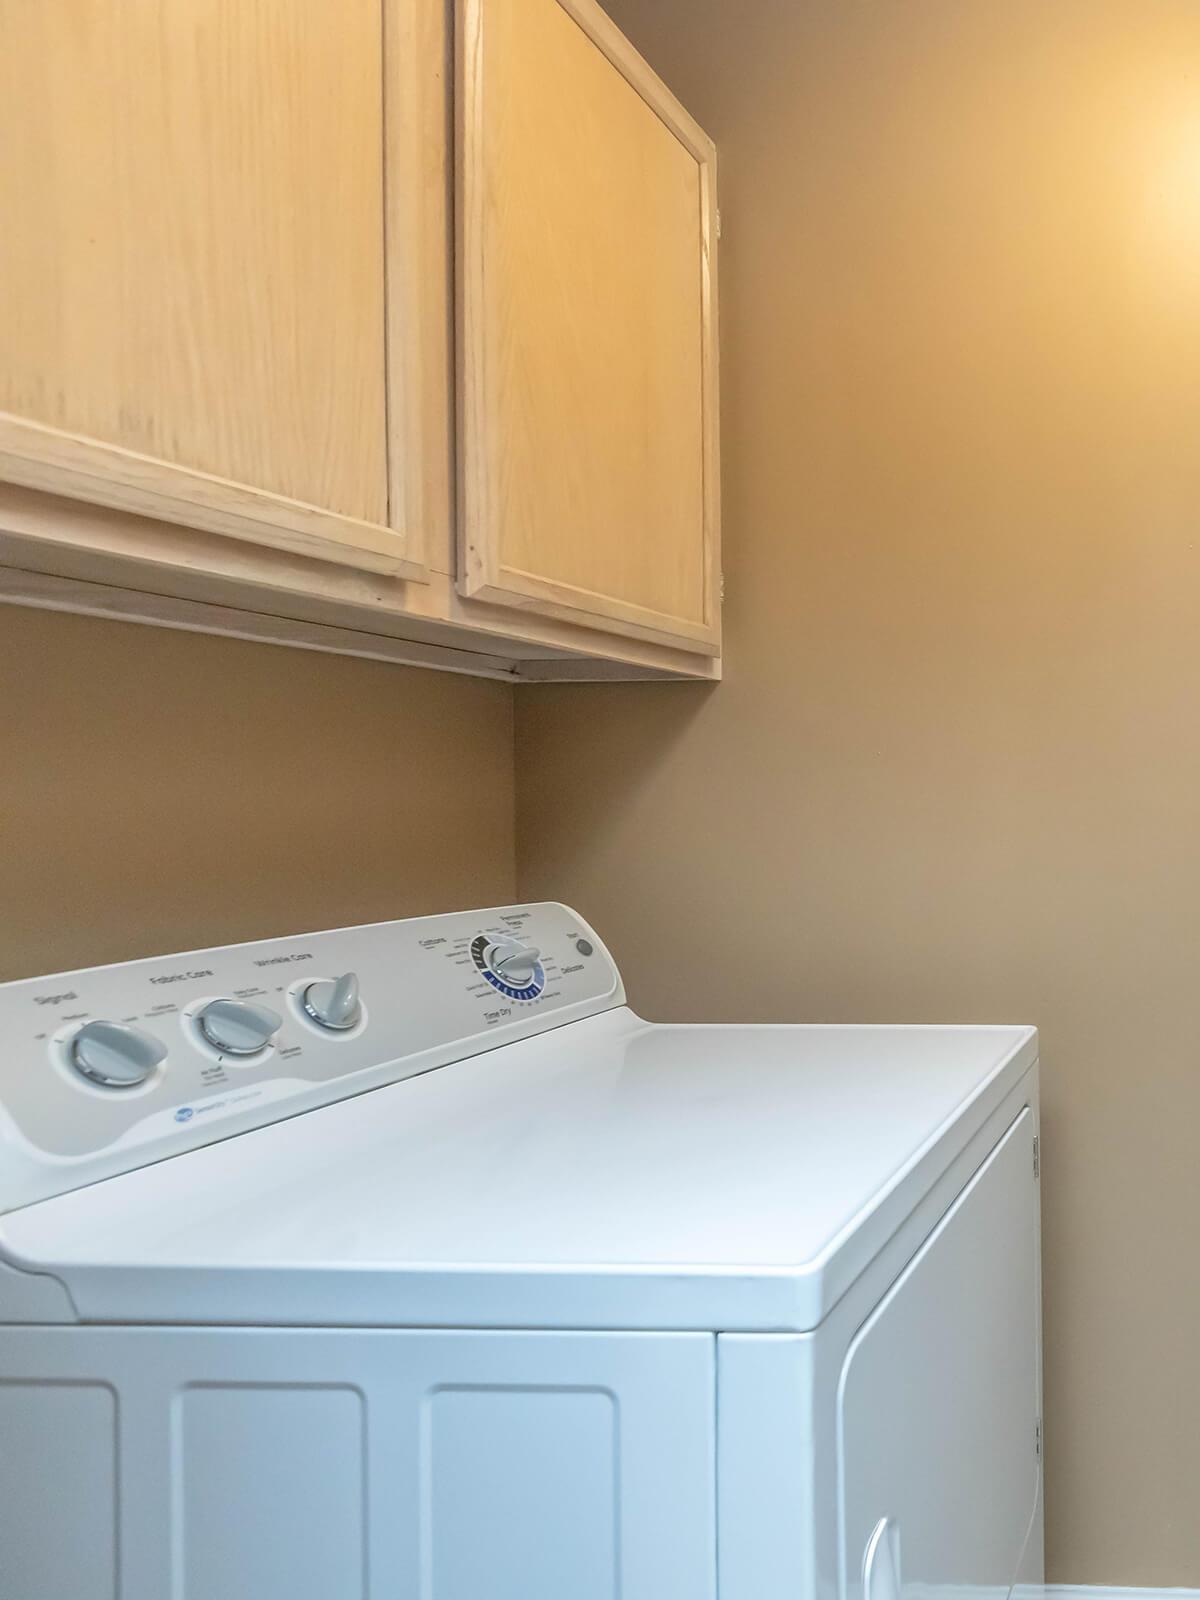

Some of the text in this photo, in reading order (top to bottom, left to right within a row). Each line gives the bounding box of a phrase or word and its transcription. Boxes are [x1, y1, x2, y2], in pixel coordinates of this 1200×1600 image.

[253, 951, 314, 967] Wrinkle Care
[149, 968, 214, 985] Fabric Care
[33, 991, 79, 1005] Signal
[483, 1008, 512, 1020] Time Dry
